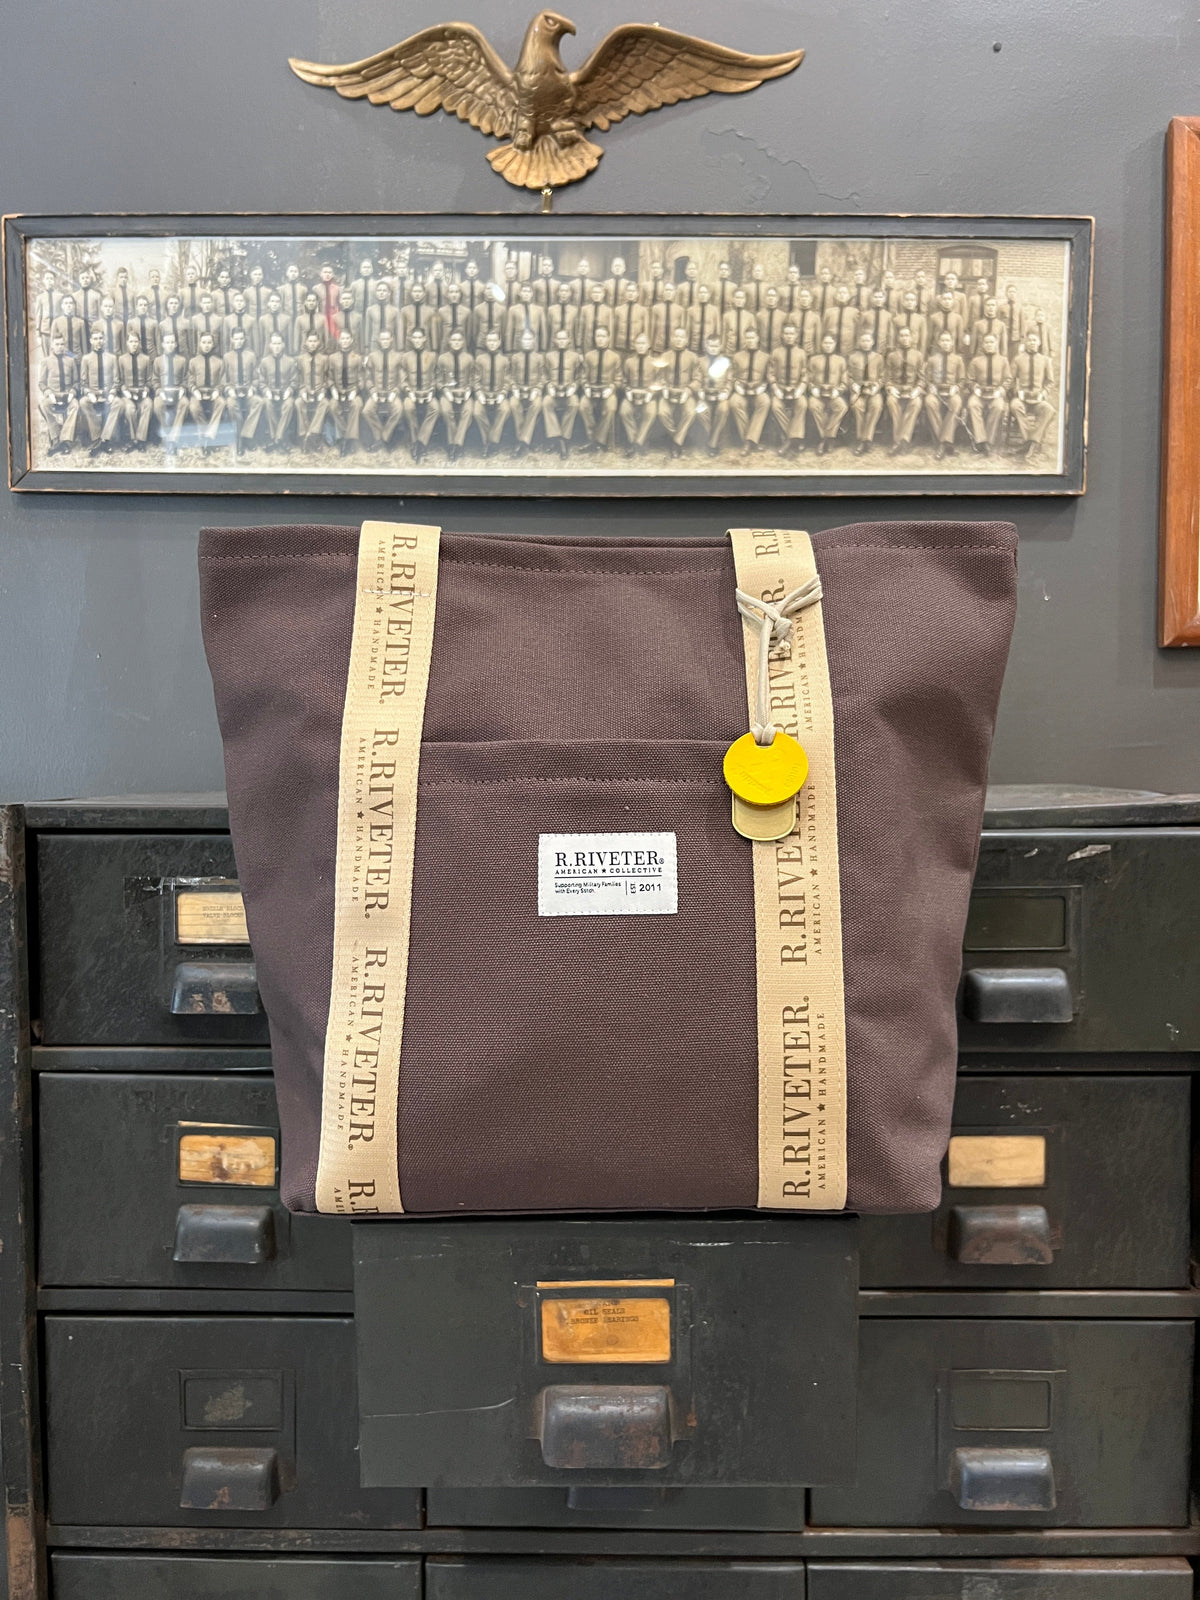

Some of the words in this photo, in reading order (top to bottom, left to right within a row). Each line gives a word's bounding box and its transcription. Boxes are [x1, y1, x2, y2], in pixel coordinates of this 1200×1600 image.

[375, 539, 386, 601] AMERICAN
[367, 619, 381, 690] HANDMADE
[795, 608, 806, 658] HANDM
[800, 673, 813, 732] AMERICAN
[355, 737, 367, 805] AMERICAN
[807, 784, 818, 862] HANDMADE
[351, 825, 364, 903] HANDMADE
[639, 883, 662, 892] 2011
[775, 789, 809, 966] R.RIVE
[810, 883, 822, 955] AMERICAN
[347, 956, 359, 1028] AMERICAN
[336, 1049, 349, 1131] HANDMADE
[816, 1012, 827, 1096] HANDMADE
[816, 1118, 827, 1190] AMERICAN
